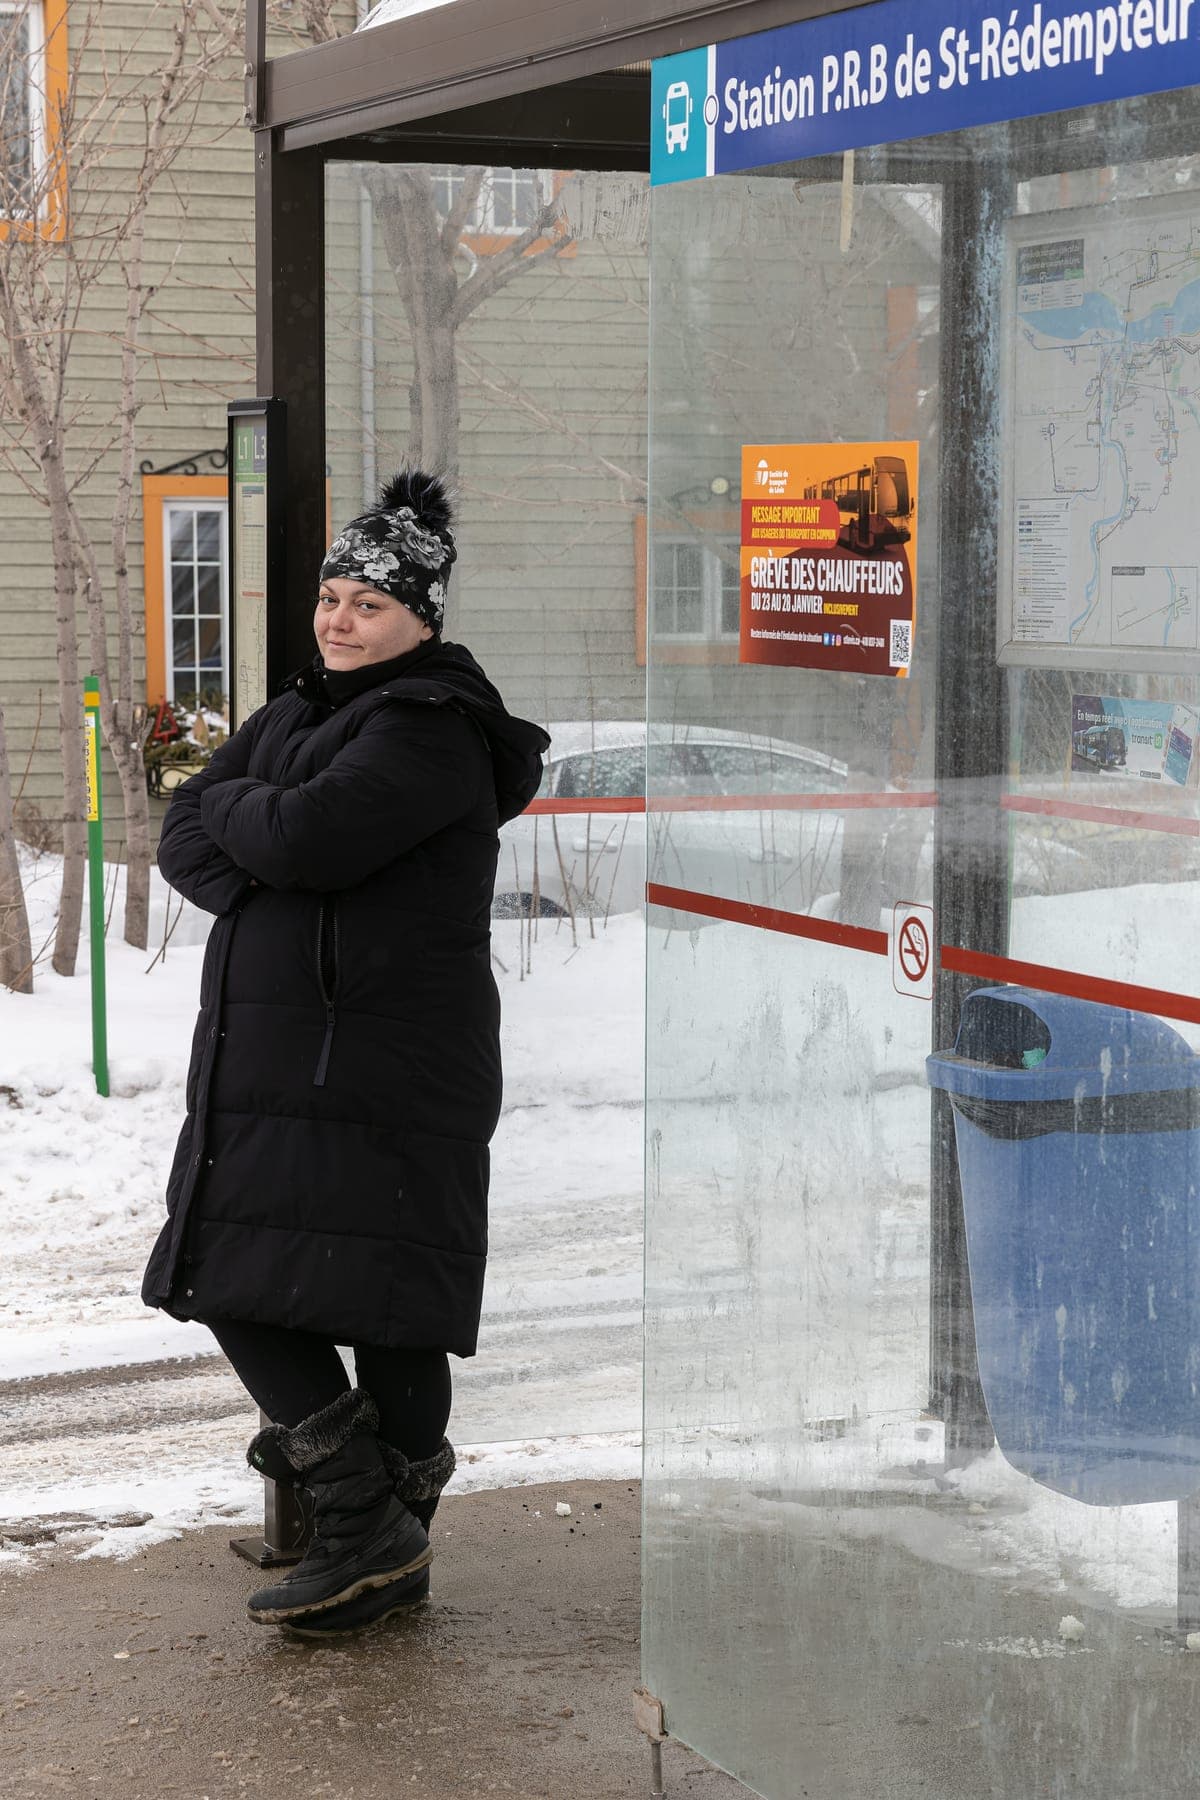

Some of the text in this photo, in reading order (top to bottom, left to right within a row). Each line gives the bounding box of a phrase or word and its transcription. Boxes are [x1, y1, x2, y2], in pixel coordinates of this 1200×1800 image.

[723, 0, 1192, 135] Station P.R.B de St-Rédempteur
[238, 435, 248, 460] L1
[751, 505, 820, 524] MESSAGE IMPORTANT
[750, 550, 904, 595] GRÈVE DES CHAUFFEURS
[751, 593, 761, 610] DU
[761, 593, 770, 611] 23
[771, 594, 781, 612] AU
[781, 594, 791, 613] 28
[791, 595, 823, 614] JANVIER
